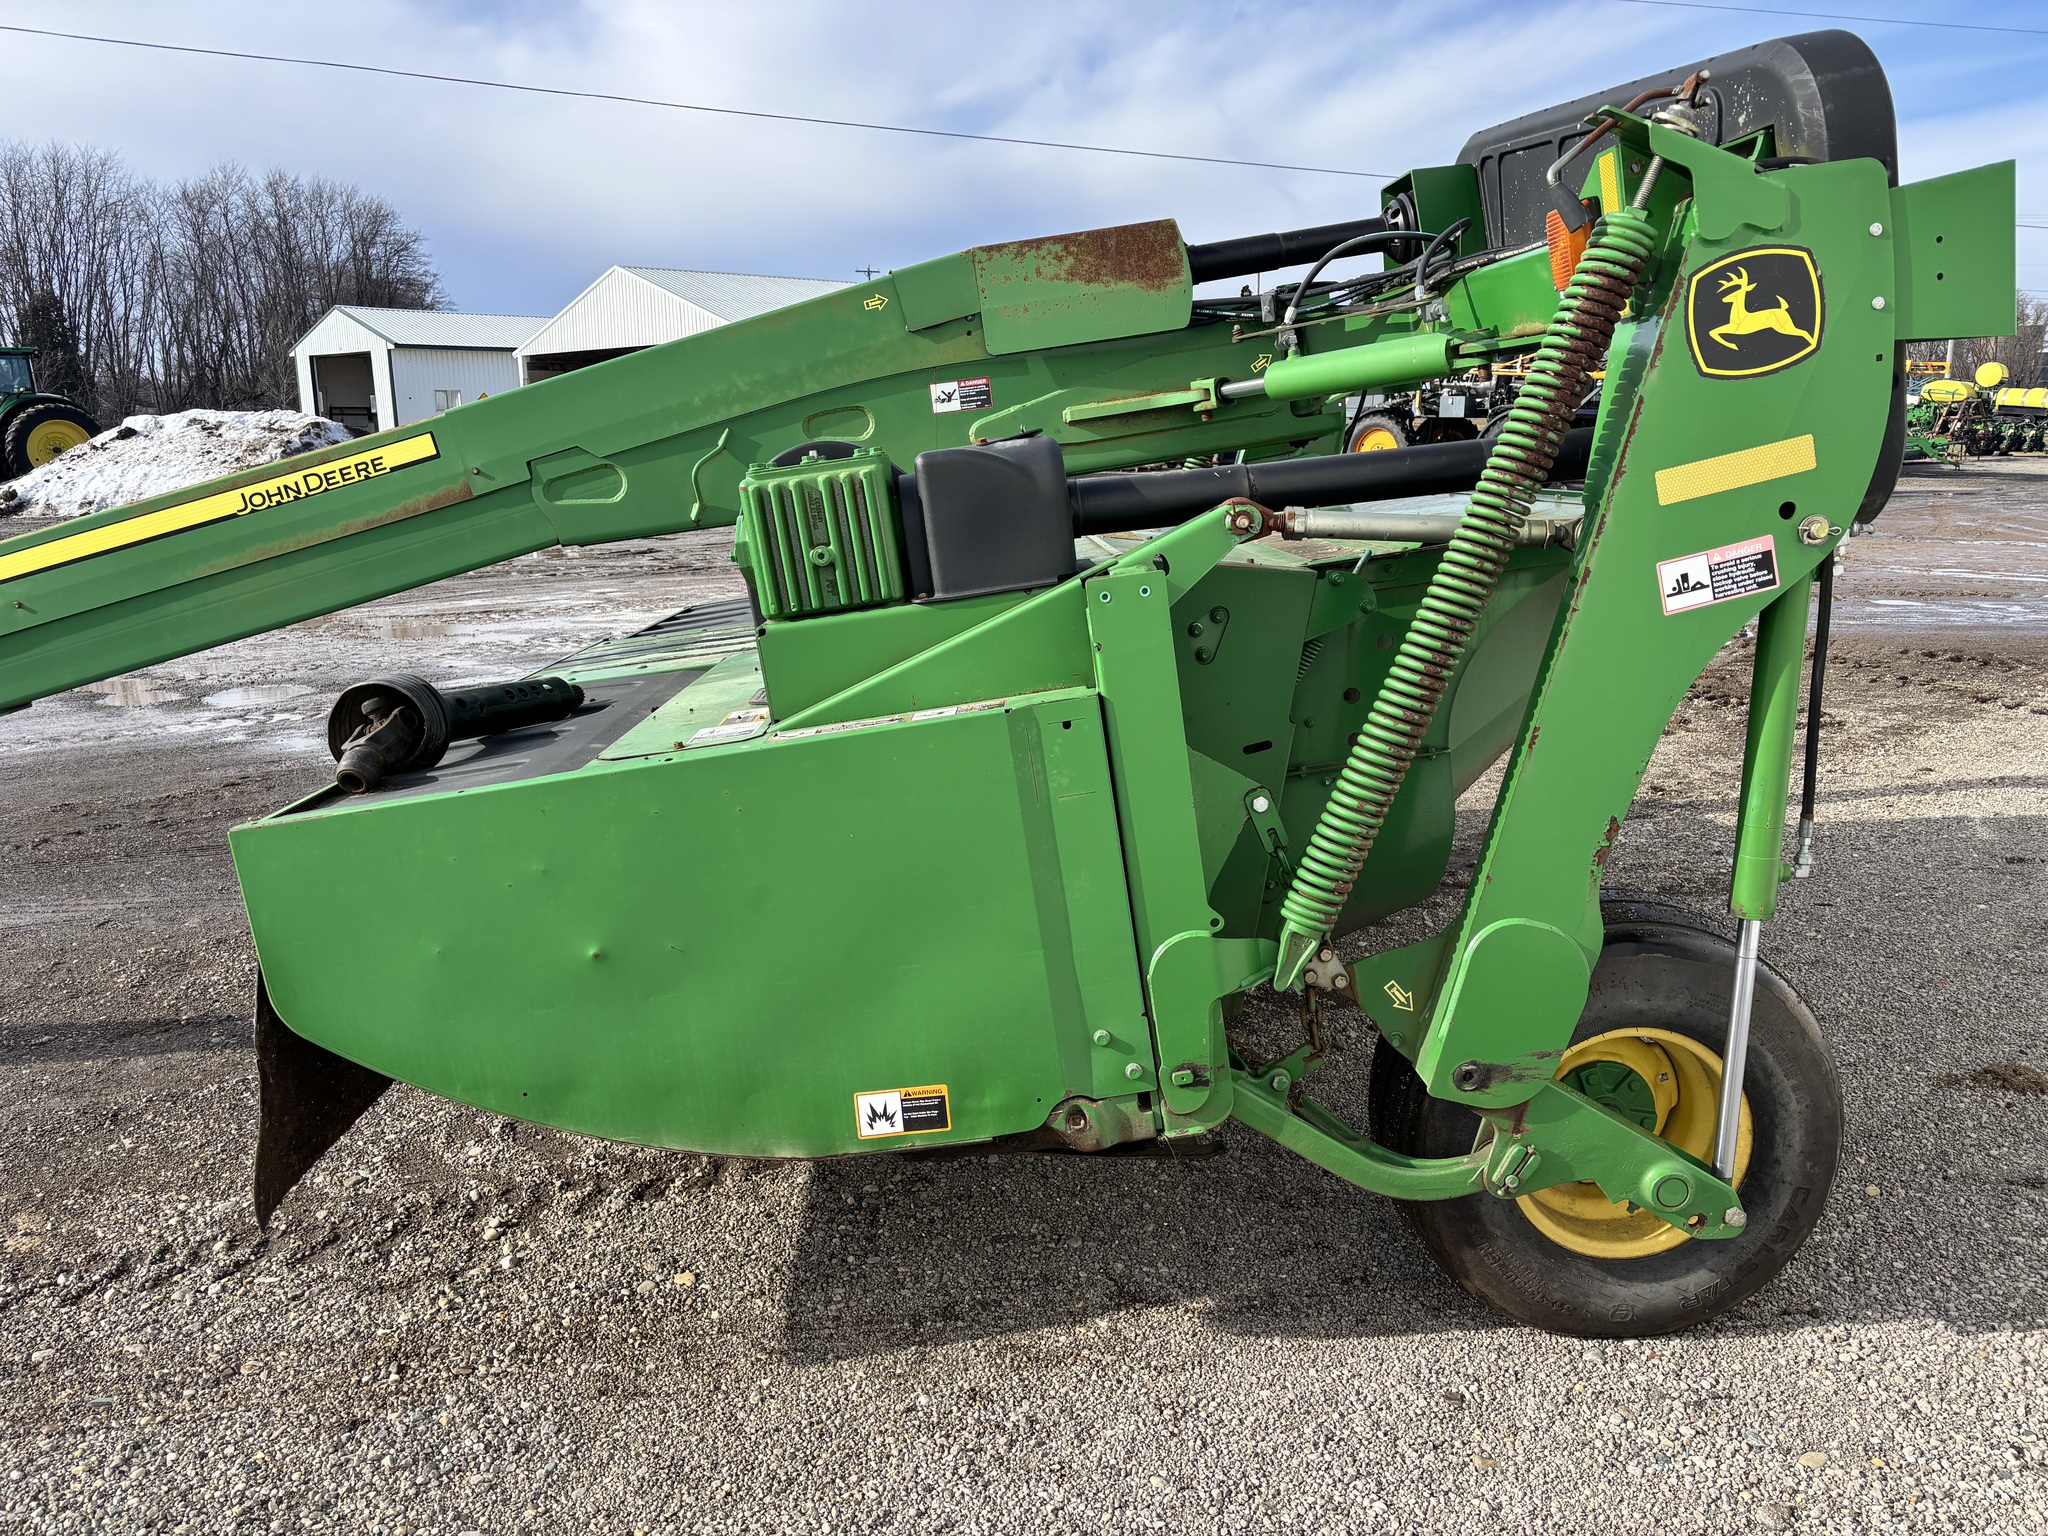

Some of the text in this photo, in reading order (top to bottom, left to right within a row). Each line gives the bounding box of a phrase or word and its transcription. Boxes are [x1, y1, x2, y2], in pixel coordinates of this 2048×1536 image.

[236, 456, 388, 513] JOHN DEERE
[1725, 543, 1763, 559] DANGER
[1720, 560, 1735, 568] avoid
[1741, 554, 1762, 563] serious
[1712, 566, 1737, 576] crushing
[1713, 568, 1755, 582] close hydraulic
[1713, 579, 1733, 587] lockup
[1750, 569, 1768, 578] before
[1714, 573, 1774, 593] working under raised
[1715, 587, 1745, 599] harvesting
[1680, 1186, 1810, 1311] CARLSTAR
